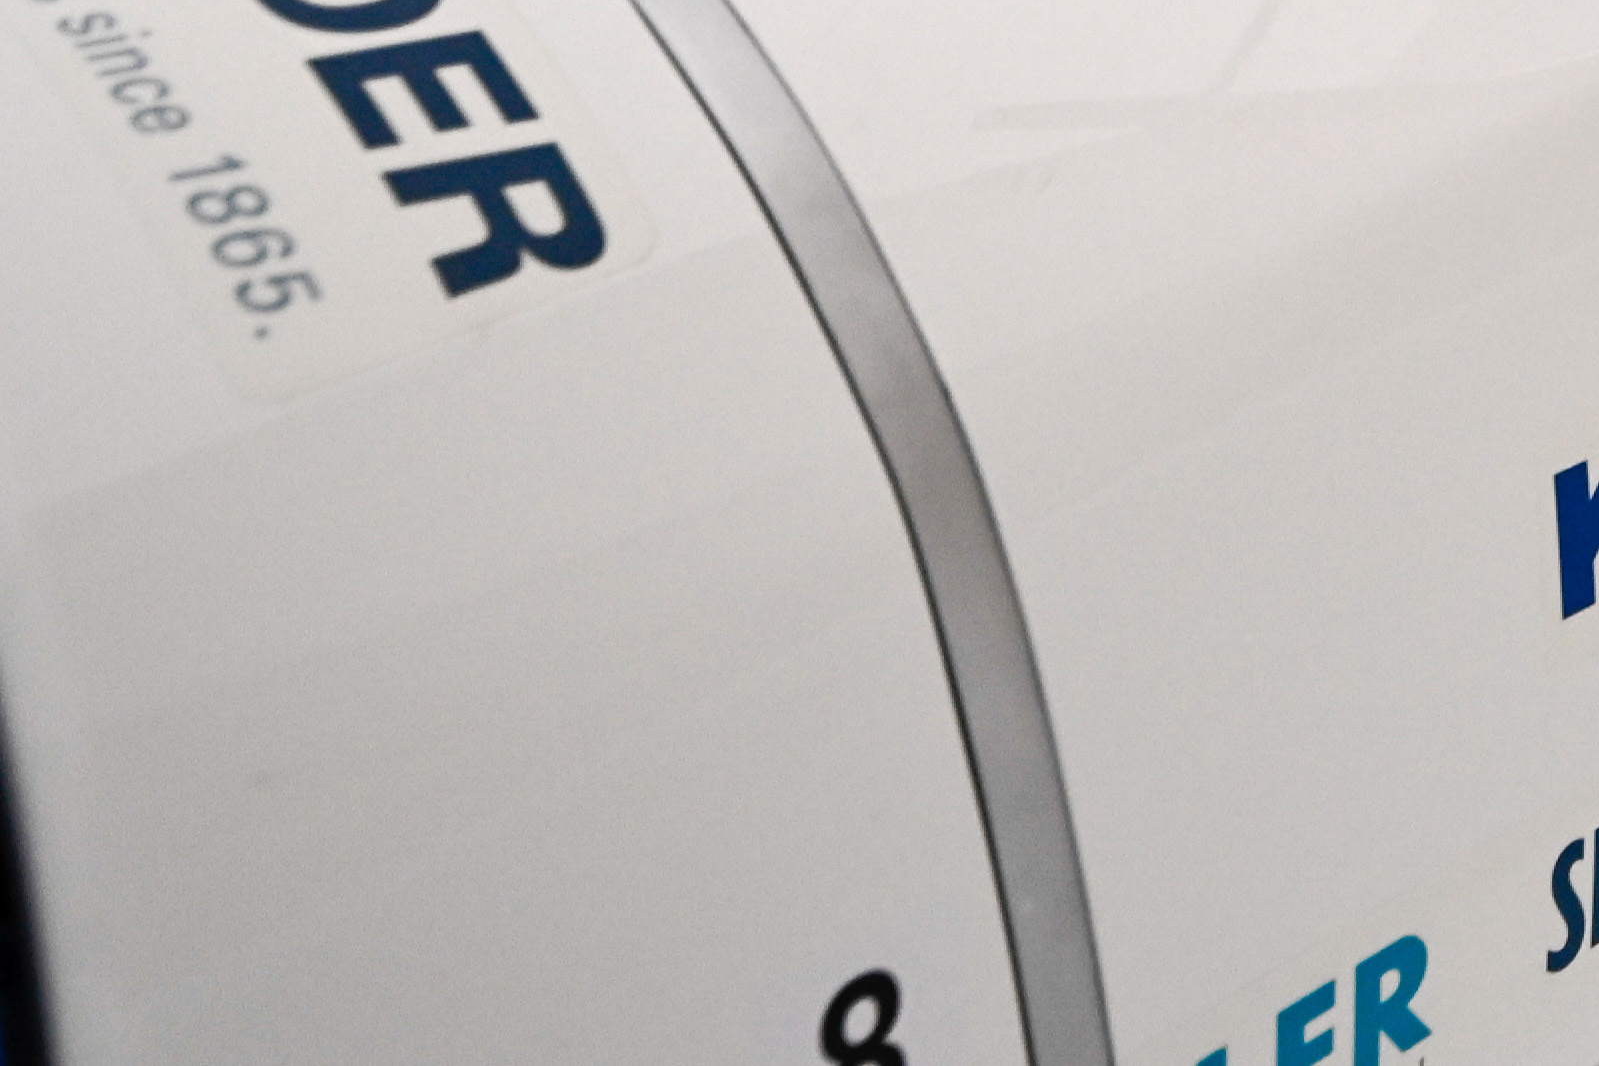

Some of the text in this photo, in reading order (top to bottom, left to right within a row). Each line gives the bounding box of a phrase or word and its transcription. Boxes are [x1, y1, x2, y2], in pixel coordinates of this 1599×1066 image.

[56, 11, 192, 137] since
[167, 152, 325, 340] 1865.
[1194, 934, 1433, 1066] ER
